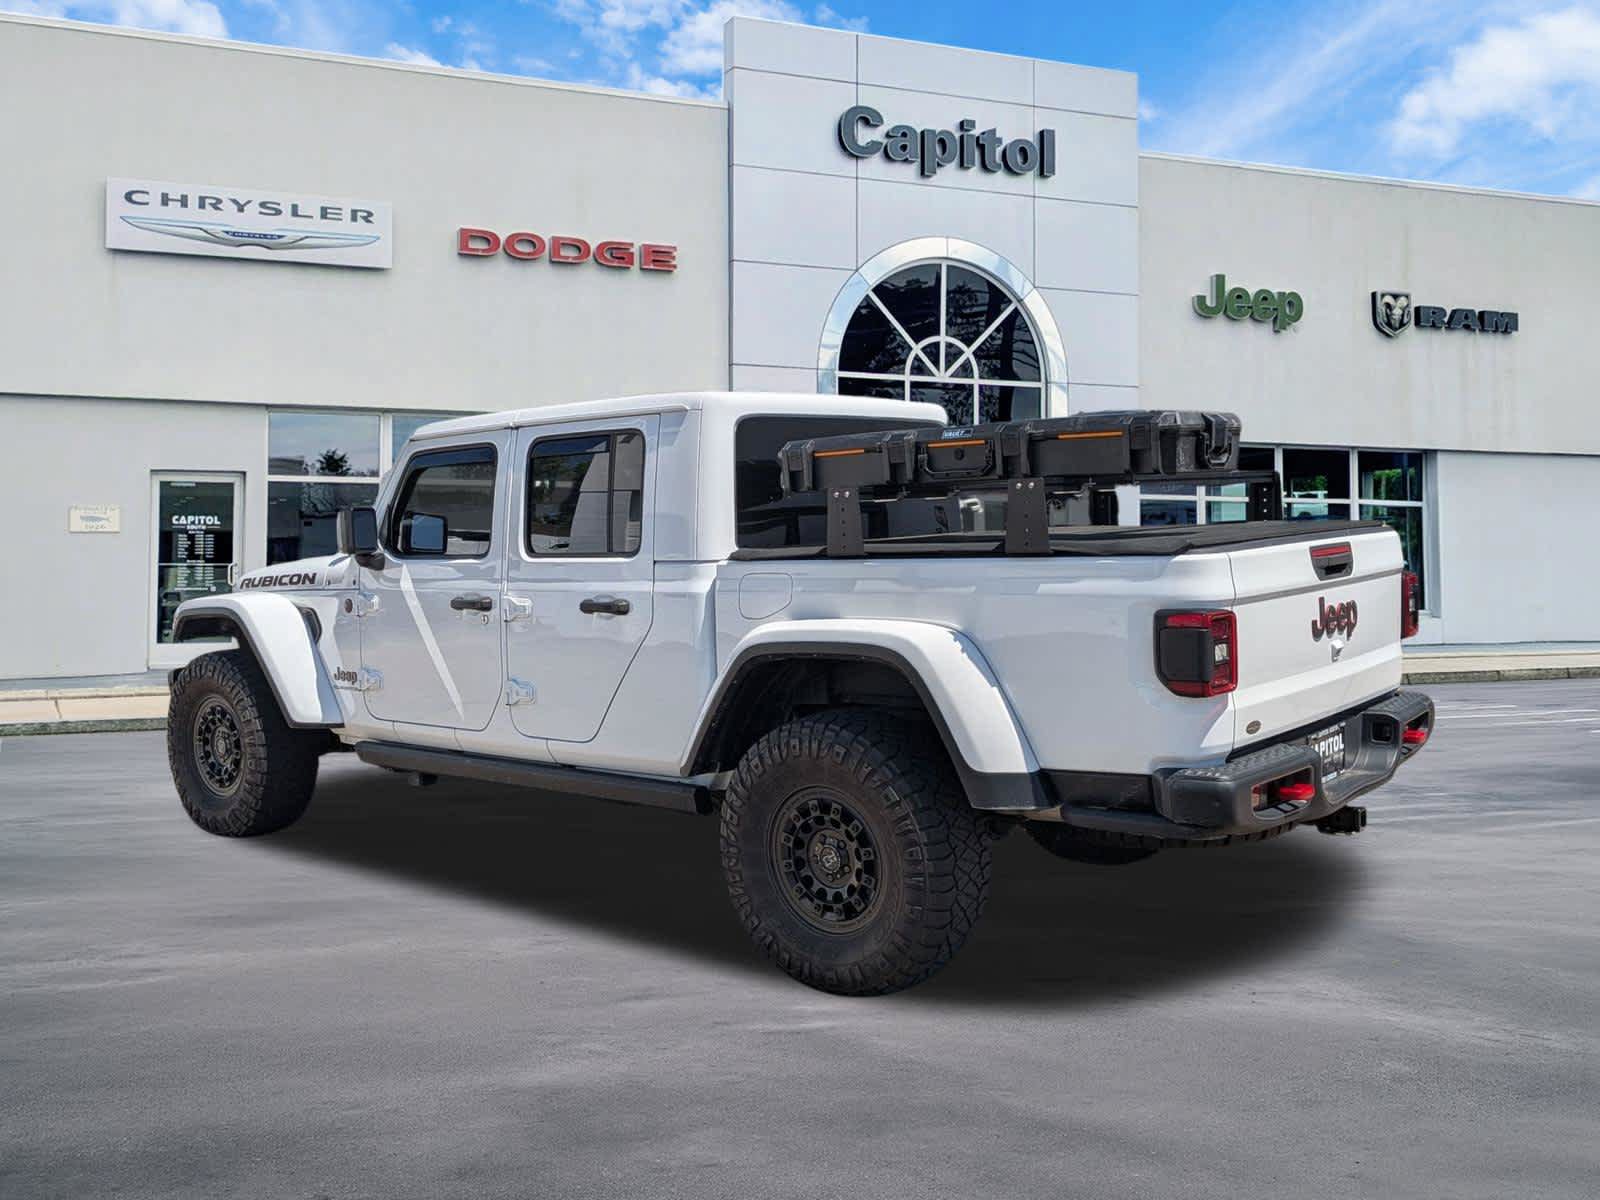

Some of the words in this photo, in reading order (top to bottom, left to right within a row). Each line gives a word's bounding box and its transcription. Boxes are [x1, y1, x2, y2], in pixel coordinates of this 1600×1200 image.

[838, 104, 1056, 177] Capitol
[124, 189, 375, 224] CHRYSLER
[457, 227, 678, 272] DODGE
[1192, 274, 1304, 333] Jeep
[1414, 305, 1519, 335] RAM
[172, 515, 221, 525] CAPITOL
[240, 573, 317, 589] RUBICON
[1311, 596, 1358, 642] Jeep
[334, 667, 358, 685] Jeep
